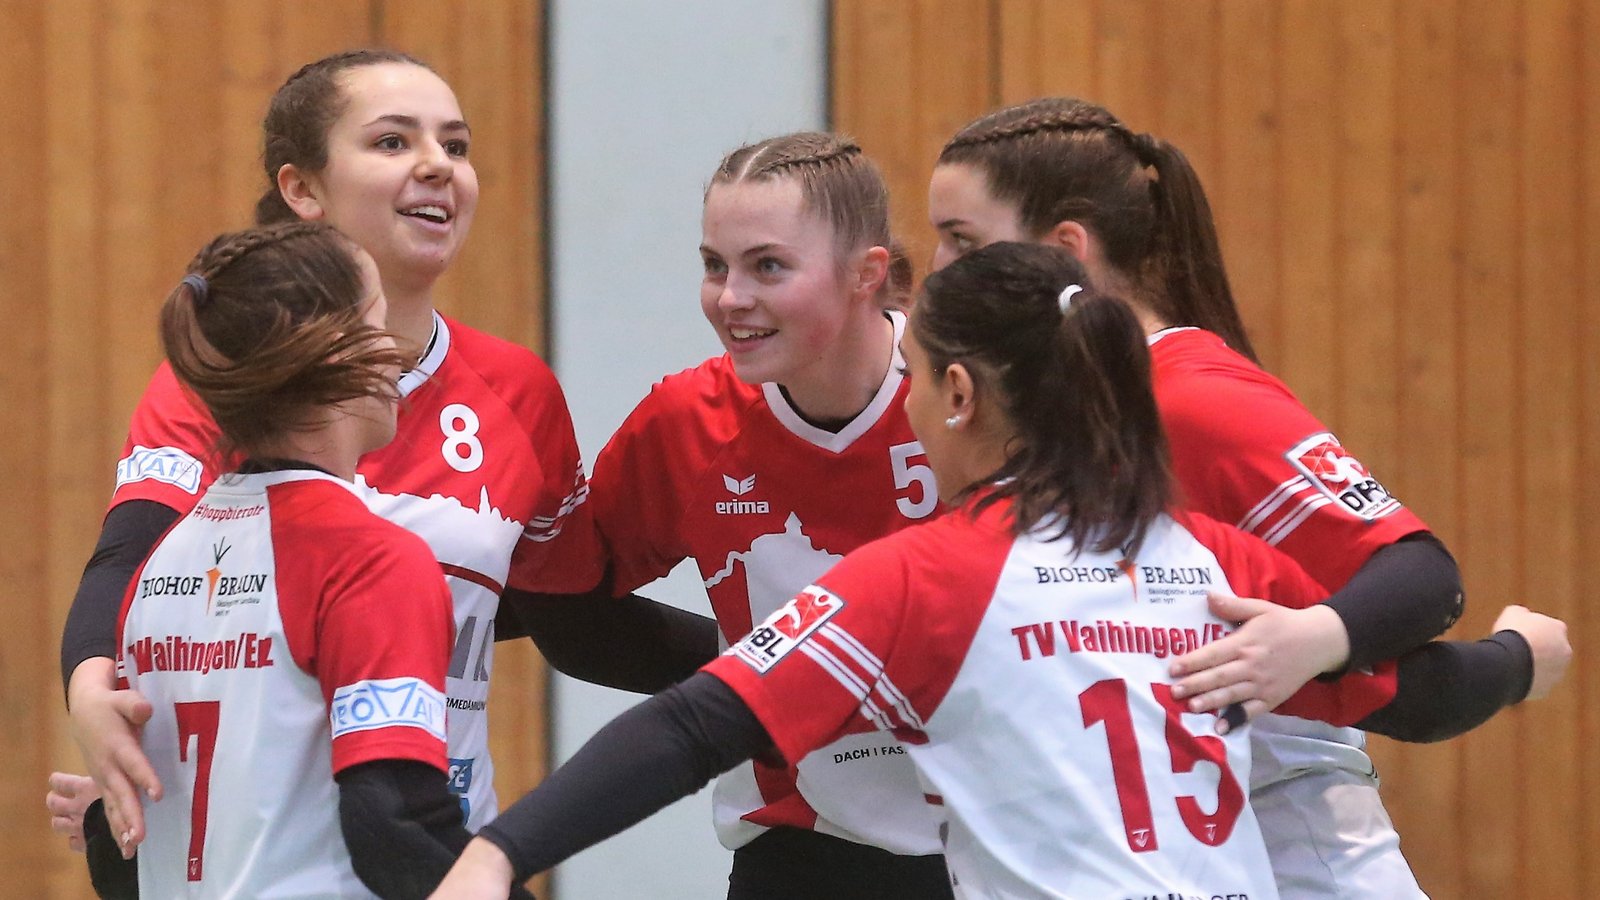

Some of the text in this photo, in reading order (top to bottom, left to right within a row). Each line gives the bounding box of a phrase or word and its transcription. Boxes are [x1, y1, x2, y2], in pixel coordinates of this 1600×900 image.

[440, 403, 483, 473] 8
[888, 440, 939, 519] 5
[715, 499, 770, 514] erima
[217, 574, 268, 596] BRAUN
[1033, 566, 1213, 585] BIOHOF BRAUN
[1011, 619, 1231, 661] TV Vaihingen/E
[834, 748, 870, 764] DACH
[1078, 678, 1247, 853] 15
[173, 700, 221, 882] 7
